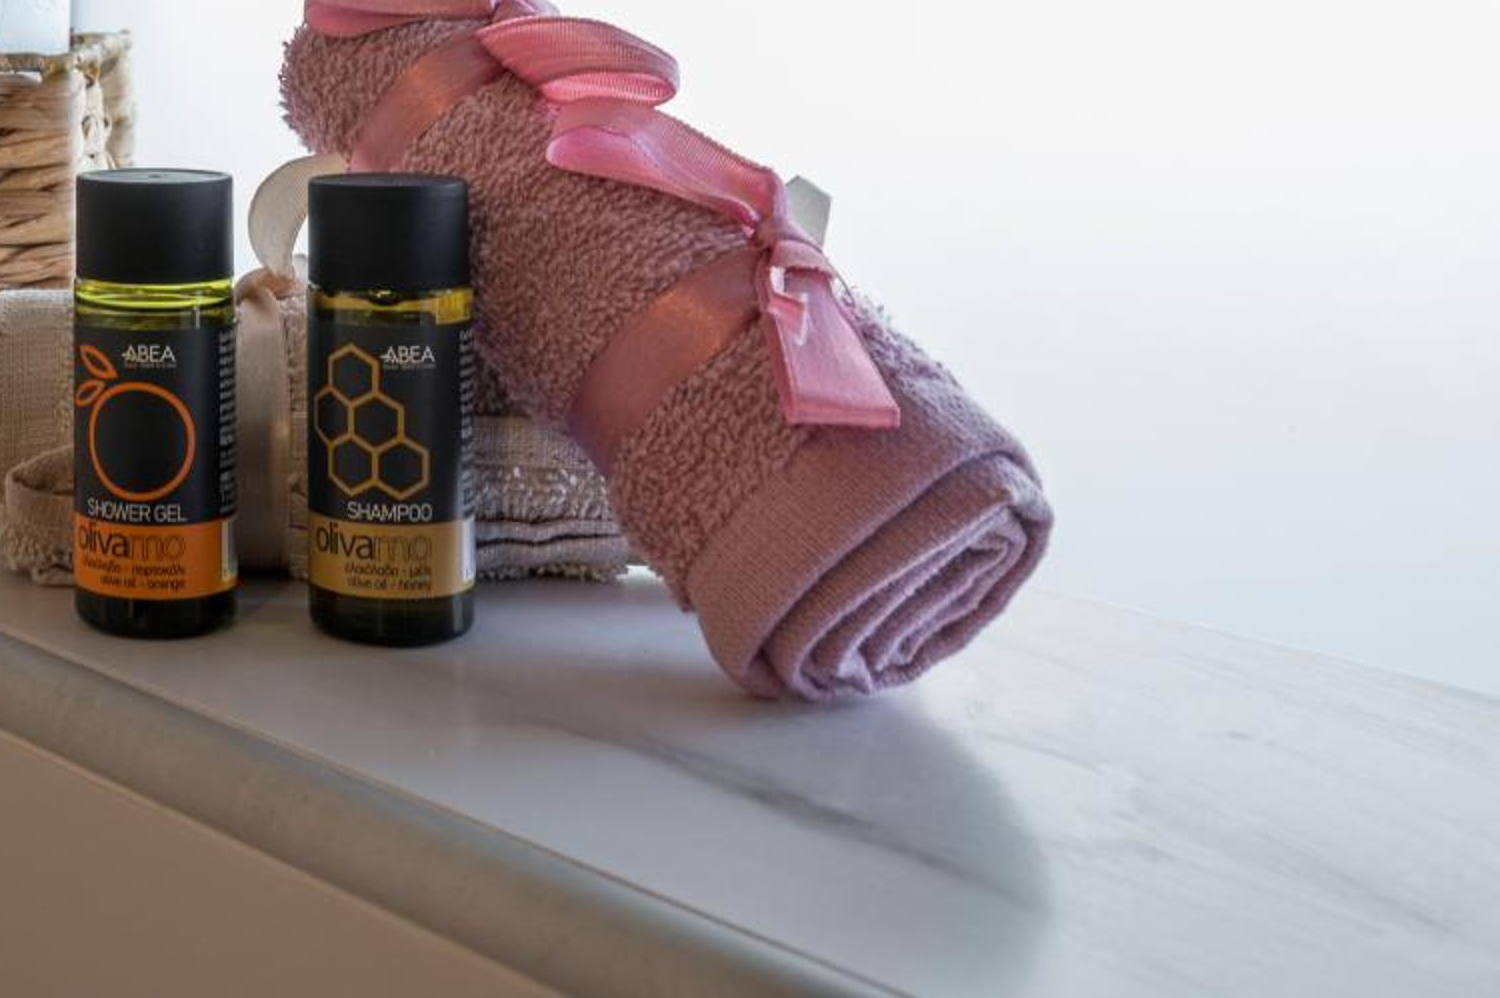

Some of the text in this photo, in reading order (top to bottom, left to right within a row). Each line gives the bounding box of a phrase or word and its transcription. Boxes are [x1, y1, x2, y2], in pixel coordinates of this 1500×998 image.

[121, 345, 176, 362] ABEA
[380, 346, 435, 363] ABEA
[87, 497, 187, 523] SHOWER GEL
[347, 501, 433, 522] SHAMPOO
